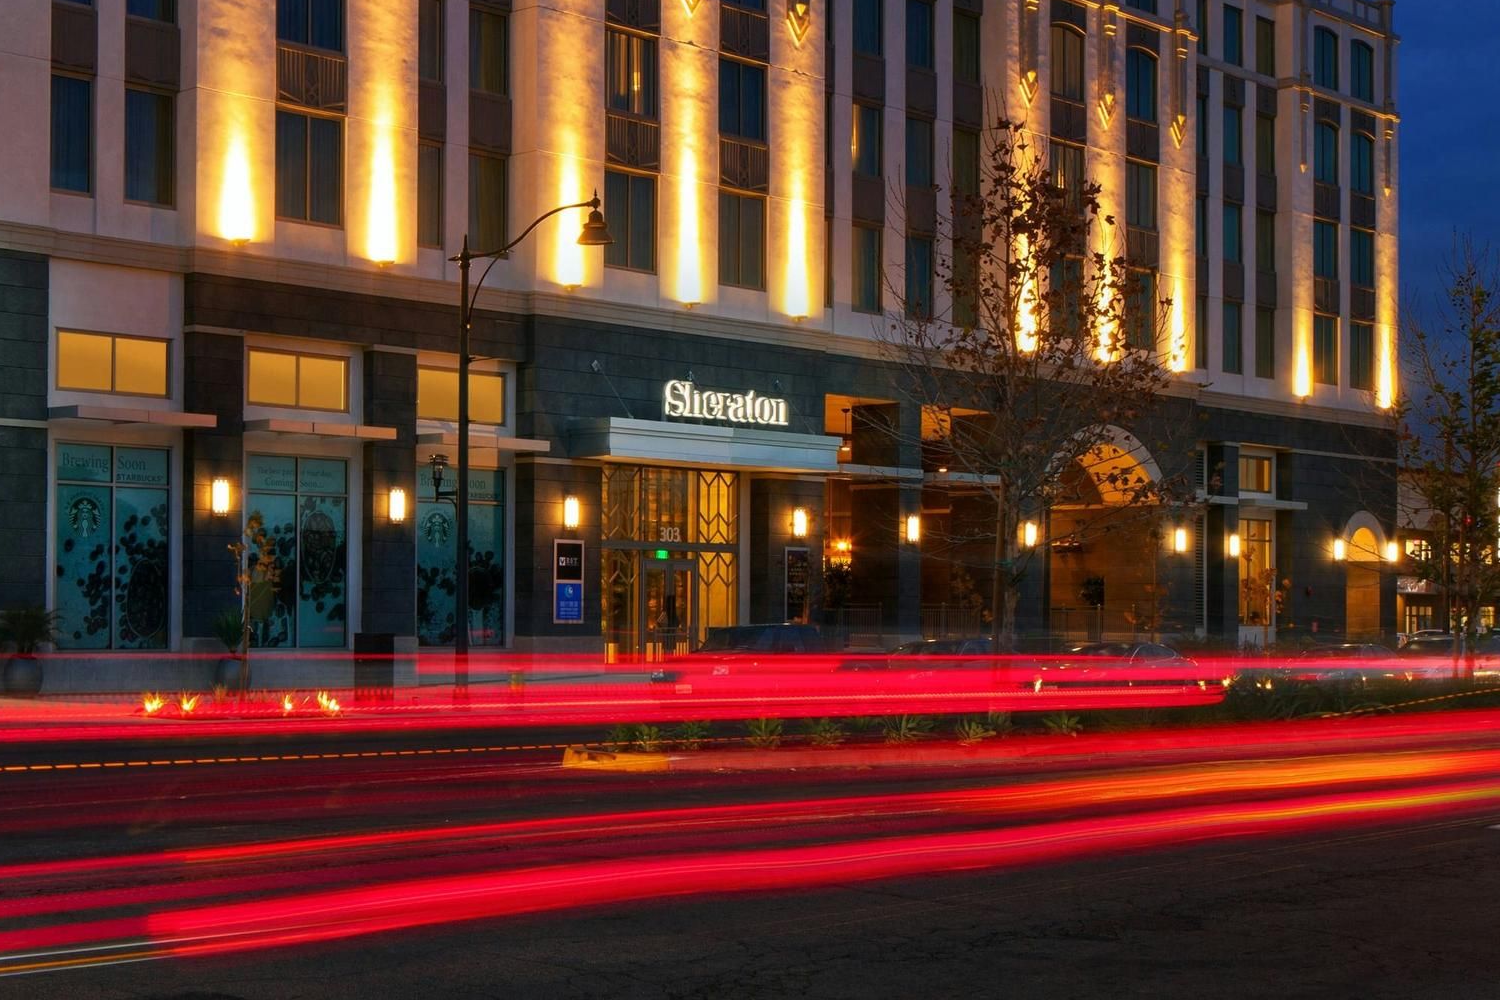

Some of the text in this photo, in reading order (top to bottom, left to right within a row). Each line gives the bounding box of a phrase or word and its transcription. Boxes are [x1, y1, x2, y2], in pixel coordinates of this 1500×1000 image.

[664, 379, 789, 426] Sheraton
[62, 452, 147, 473] Brewing Soon
[660, 526, 681, 542] 303
